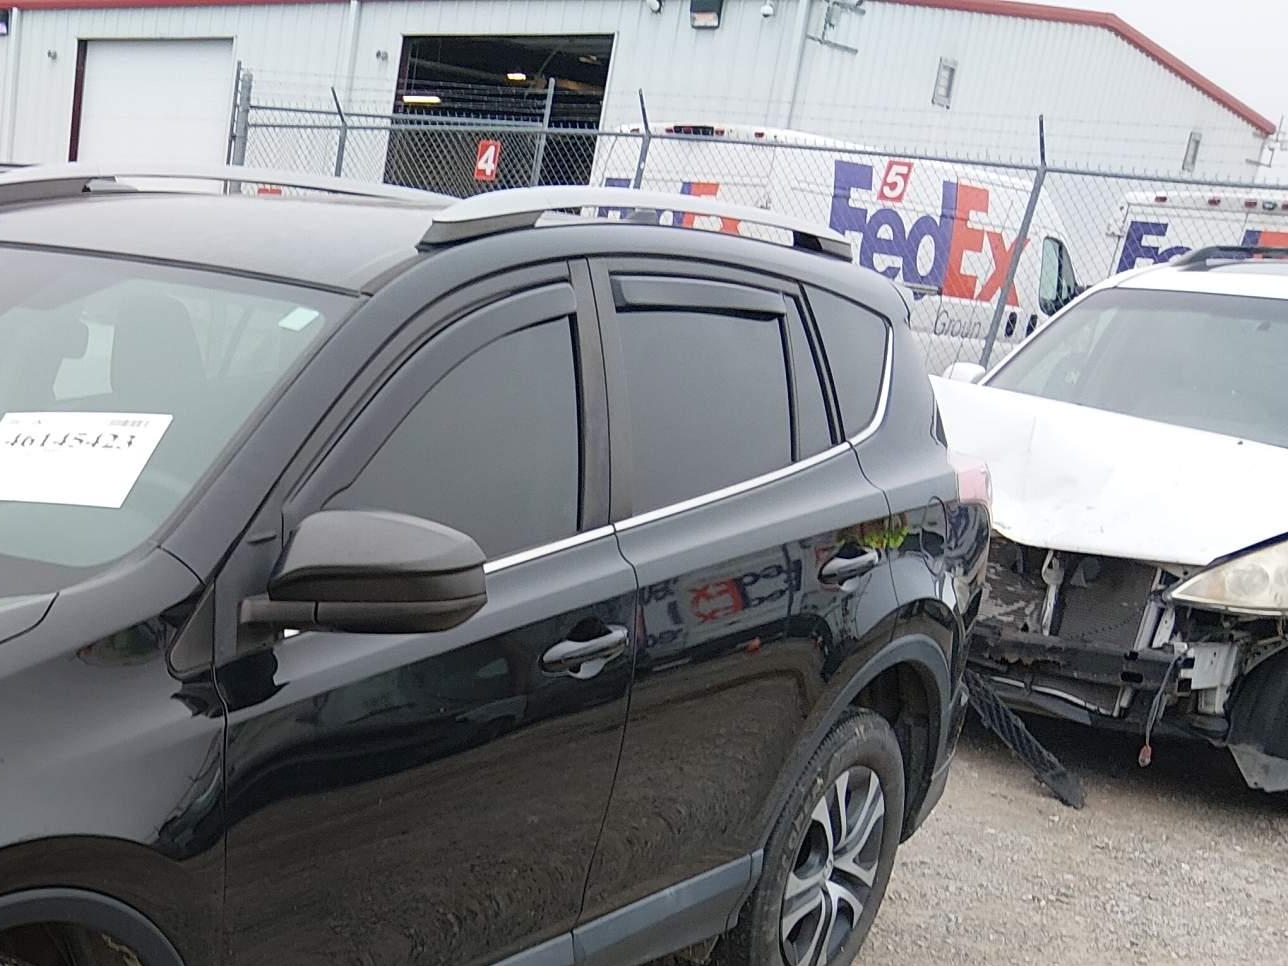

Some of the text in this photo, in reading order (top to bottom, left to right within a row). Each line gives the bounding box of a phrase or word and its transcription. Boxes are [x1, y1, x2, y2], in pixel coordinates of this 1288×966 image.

[477, 144, 496, 176] 4
[882, 164, 909, 199] 5
[829, 159, 1031, 308] FedEx
[933, 309, 983, 339] Groun
